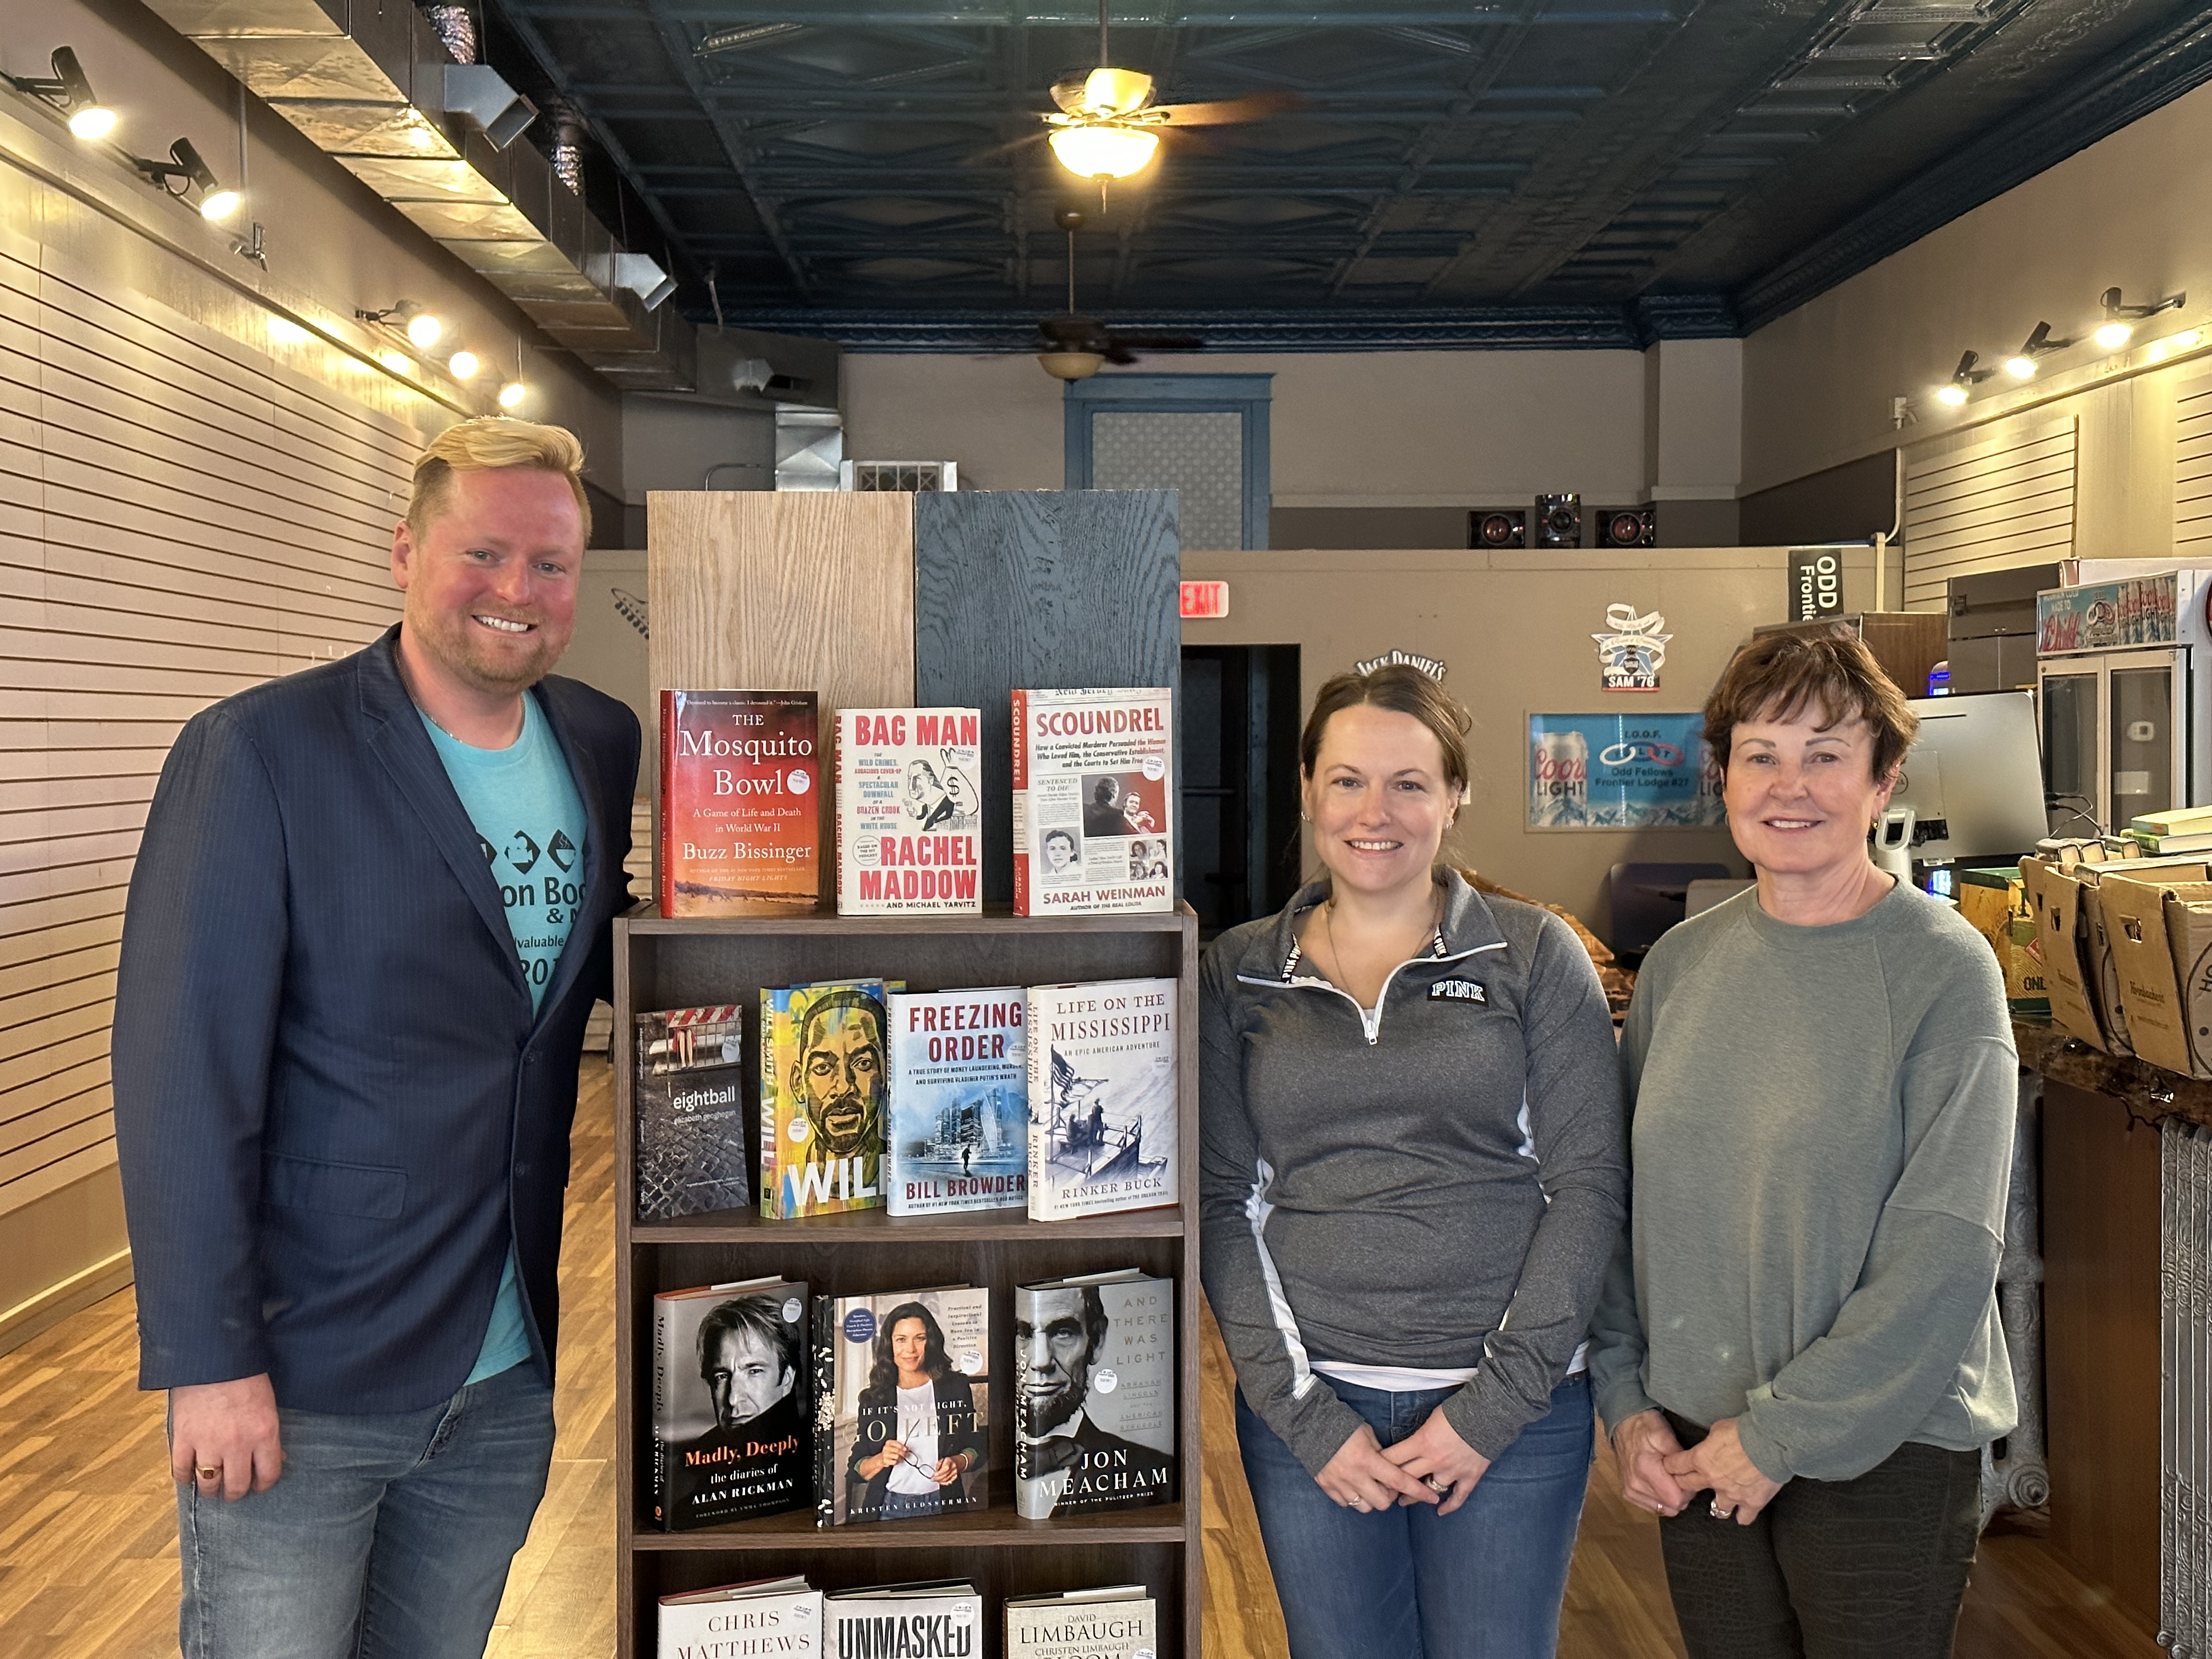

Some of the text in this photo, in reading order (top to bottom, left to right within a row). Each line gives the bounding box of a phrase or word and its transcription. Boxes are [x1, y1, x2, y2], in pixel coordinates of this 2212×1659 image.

[1817, 556, 1837, 608] ODD
[1182, 584, 1221, 614] EXIT
[2064, 602, 2071, 610] TO
[1609, 676, 1655, 687] SAM '76
[732, 714, 764, 726] THE
[855, 715, 977, 746] BAG MAN
[1036, 708, 1164, 737] SCOUNDREL
[680, 730, 812, 765] Mosquito
[1093, 749, 1128, 757] Conservative
[1129, 747, 1165, 755] Establishment,
[713, 769, 783, 795] Bowl
[1611, 767, 1673, 776] Odd Fellows
[1537, 781, 1584, 795] LIGHT
[1595, 778, 1634, 787] Frontier
[1638, 777, 1669, 788] Lodge
[693, 808, 802, 817] A Game of Life and Death
[715, 823, 781, 833] in World War II
[682, 842, 811, 864] Buzz Bissinger
[881, 836, 977, 866] RACHEL
[860, 870, 977, 900] MADDOW
[1043, 885, 1165, 904] SARAH WEINMAN
[546, 908, 563, 924] &
[1432, 980, 1485, 1002] PINK
[1057, 994, 1165, 1014] LIFE ON THE
[910, 1002, 1022, 1032] FREEZING
[1051, 1013, 1170, 1042] MISSISSIPPI
[928, 1034, 1004, 1062] ORDER
[1075, 1047, 1090, 1056] EPIC
[1093, 1045, 1124, 1054] AMERICAN
[1126, 1041, 1160, 1052] ADVENTURE
[673, 1086, 735, 1112] eightball
[674, 1110, 736, 1125] elizabeth geoghegan
[761, 1097, 775, 1169] WILL
[906, 1174, 1026, 1200] BILL BROWDER
[1062, 1178, 1162, 1199] RINKER BUCK
[1124, 1296, 1158, 1308] AND
[1114, 1314, 1169, 1328] THERE
[1124, 1334, 1158, 1346] WAS
[1116, 1352, 1166, 1365] LIGHT
[878, 1406, 898, 1414] IT'S
[904, 1404, 923, 1412] NOT
[930, 1400, 967, 1411] RIGHT,
[843, 1412, 984, 1444] GO LEFT
[685, 1435, 799, 1467] Madly, Deeply
[1081, 1449, 1127, 1470] JON
[711, 1463, 778, 1484] the diaries of
[1040, 1468, 1167, 1498] MEACHAM
[691, 1478, 793, 1505] ALAN RICKMAN
[850, 1497, 977, 1515] KRISTEN GLOSSERMAN
[708, 1610, 780, 1633] CHRIS
[1068, 1613, 1096, 1623] DAVID
[838, 1615, 970, 1659] UNMASKED
[1021, 1620, 1143, 1644] LIMBAUGH
[677, 1634, 810, 1659] MATTHEWS
[1035, 1646, 1079, 1656] CHRISTEN
[1083, 1643, 1128, 1653] LIMBAUGH
